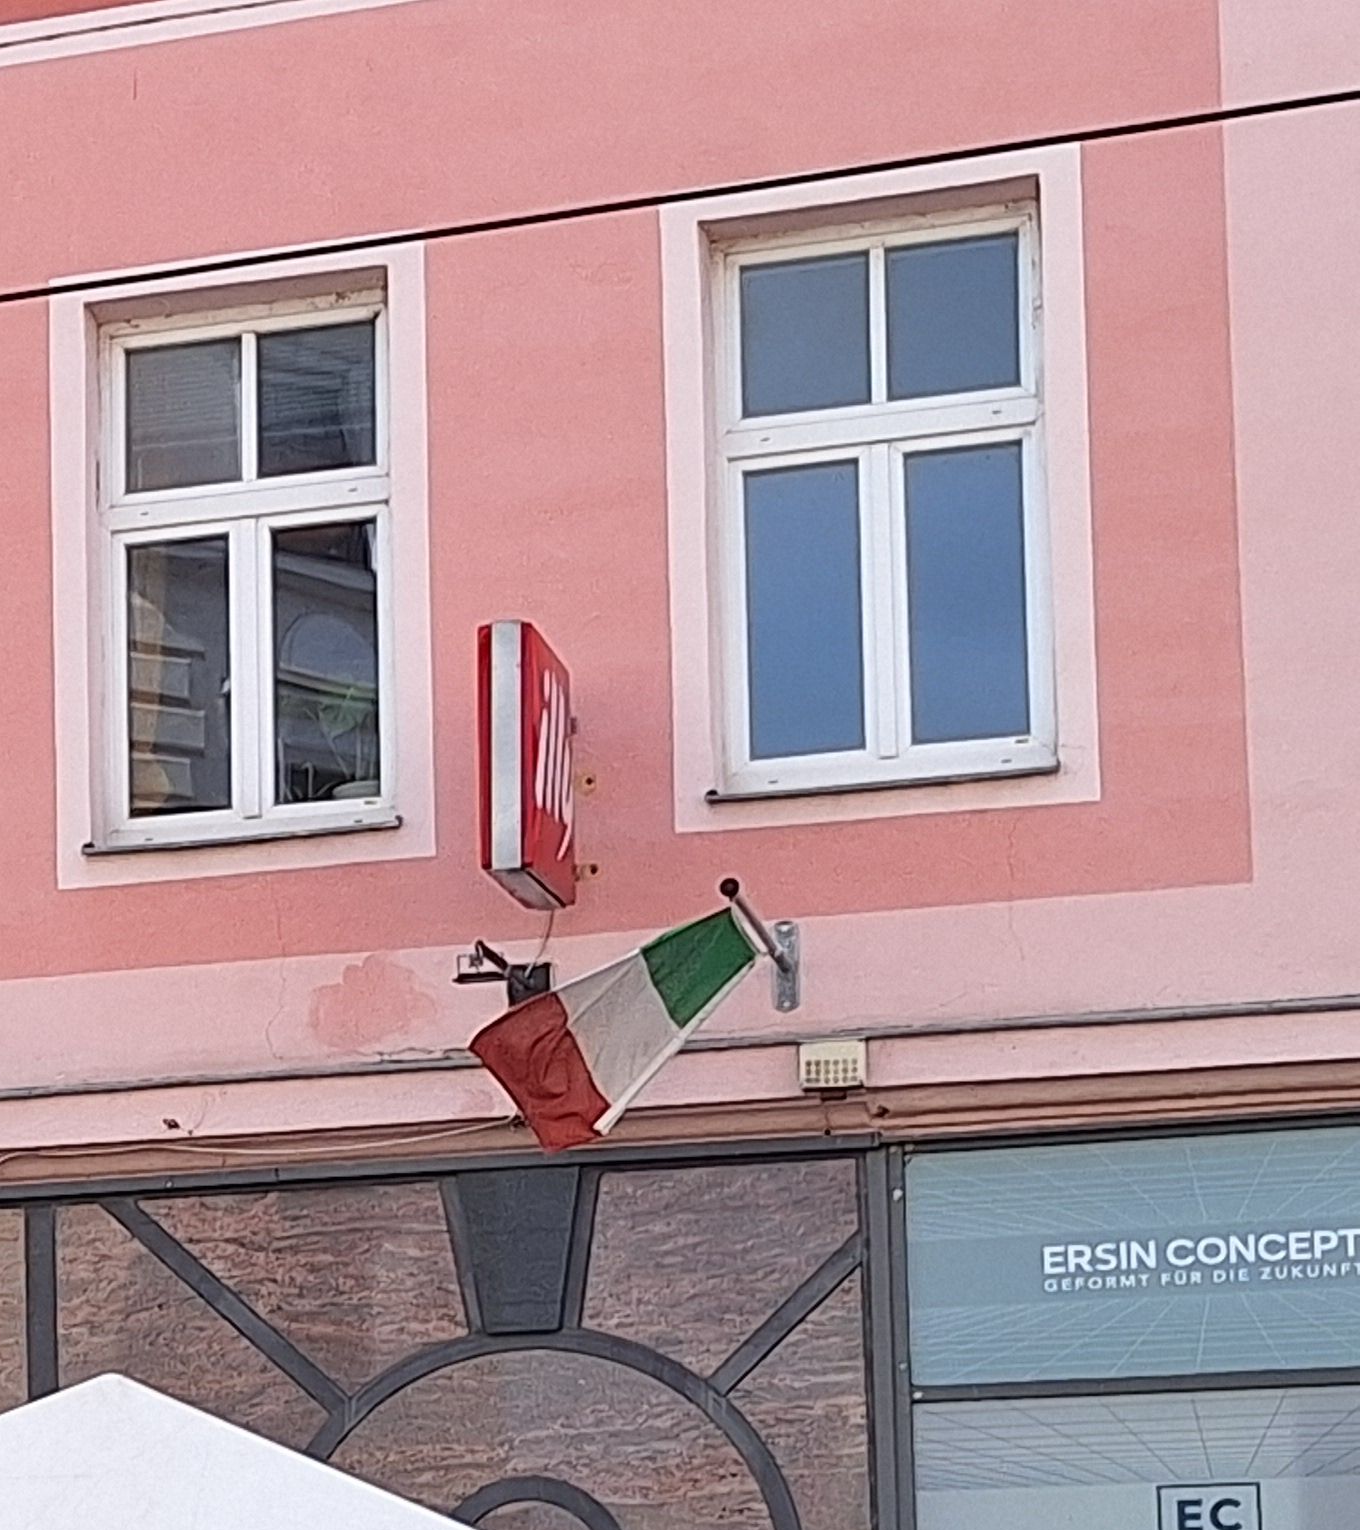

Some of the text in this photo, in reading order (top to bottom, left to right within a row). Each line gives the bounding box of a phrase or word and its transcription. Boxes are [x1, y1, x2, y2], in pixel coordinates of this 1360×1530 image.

[1042, 1228, 1360, 1275] ERSIN CONCEPT
[1043, 1262, 1360, 1293] GEFORMT FÜR DIE ZUKUNFT
